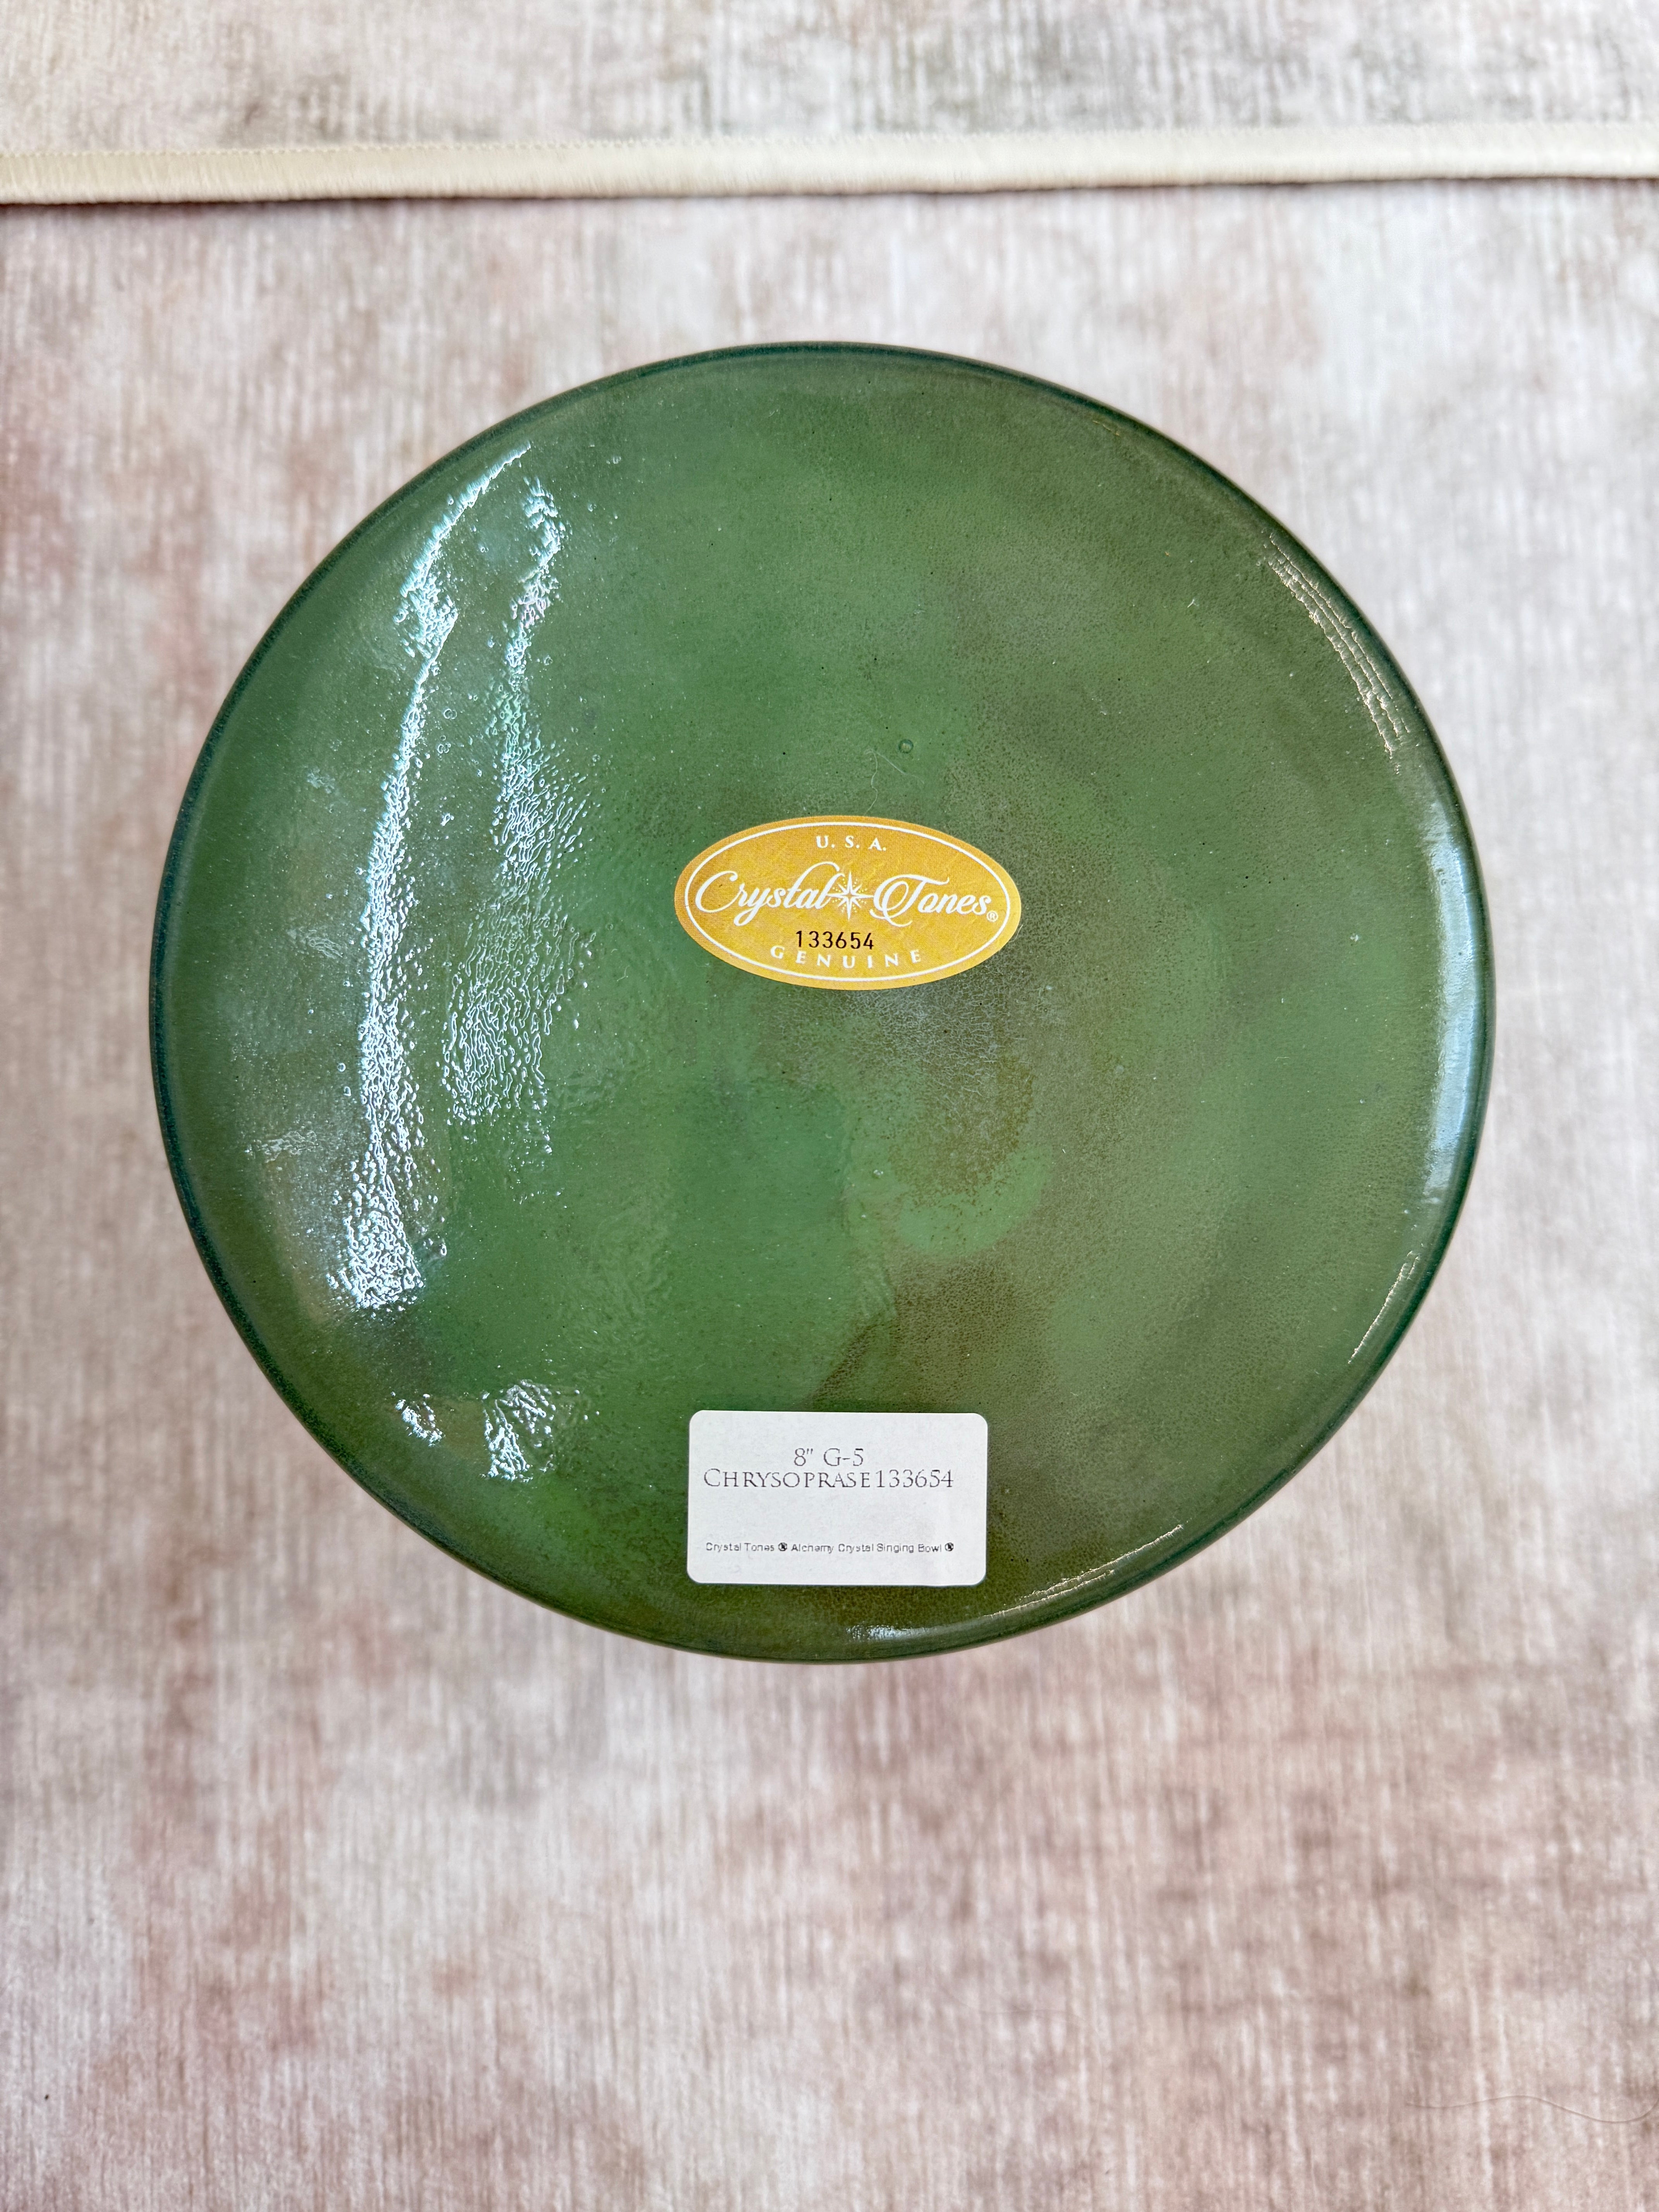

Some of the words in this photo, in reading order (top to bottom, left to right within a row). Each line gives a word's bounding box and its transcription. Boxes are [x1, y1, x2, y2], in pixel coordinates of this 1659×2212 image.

[696, 861, 845, 926] Crystal
[795, 930, 874, 950] 133654
[770, 945, 922, 969] GENUINE
[823, 1448, 864, 1467] G-5
[706, 1542, 742, 1553] Crystal
[744, 1543, 775, 1552] Tones
[791, 1542, 834, 1553] Alchemy
[838, 1543, 874, 1553] Crystal
[877, 1543, 914, 1554] Singing
[918, 1543, 942, 1553] Bowl
